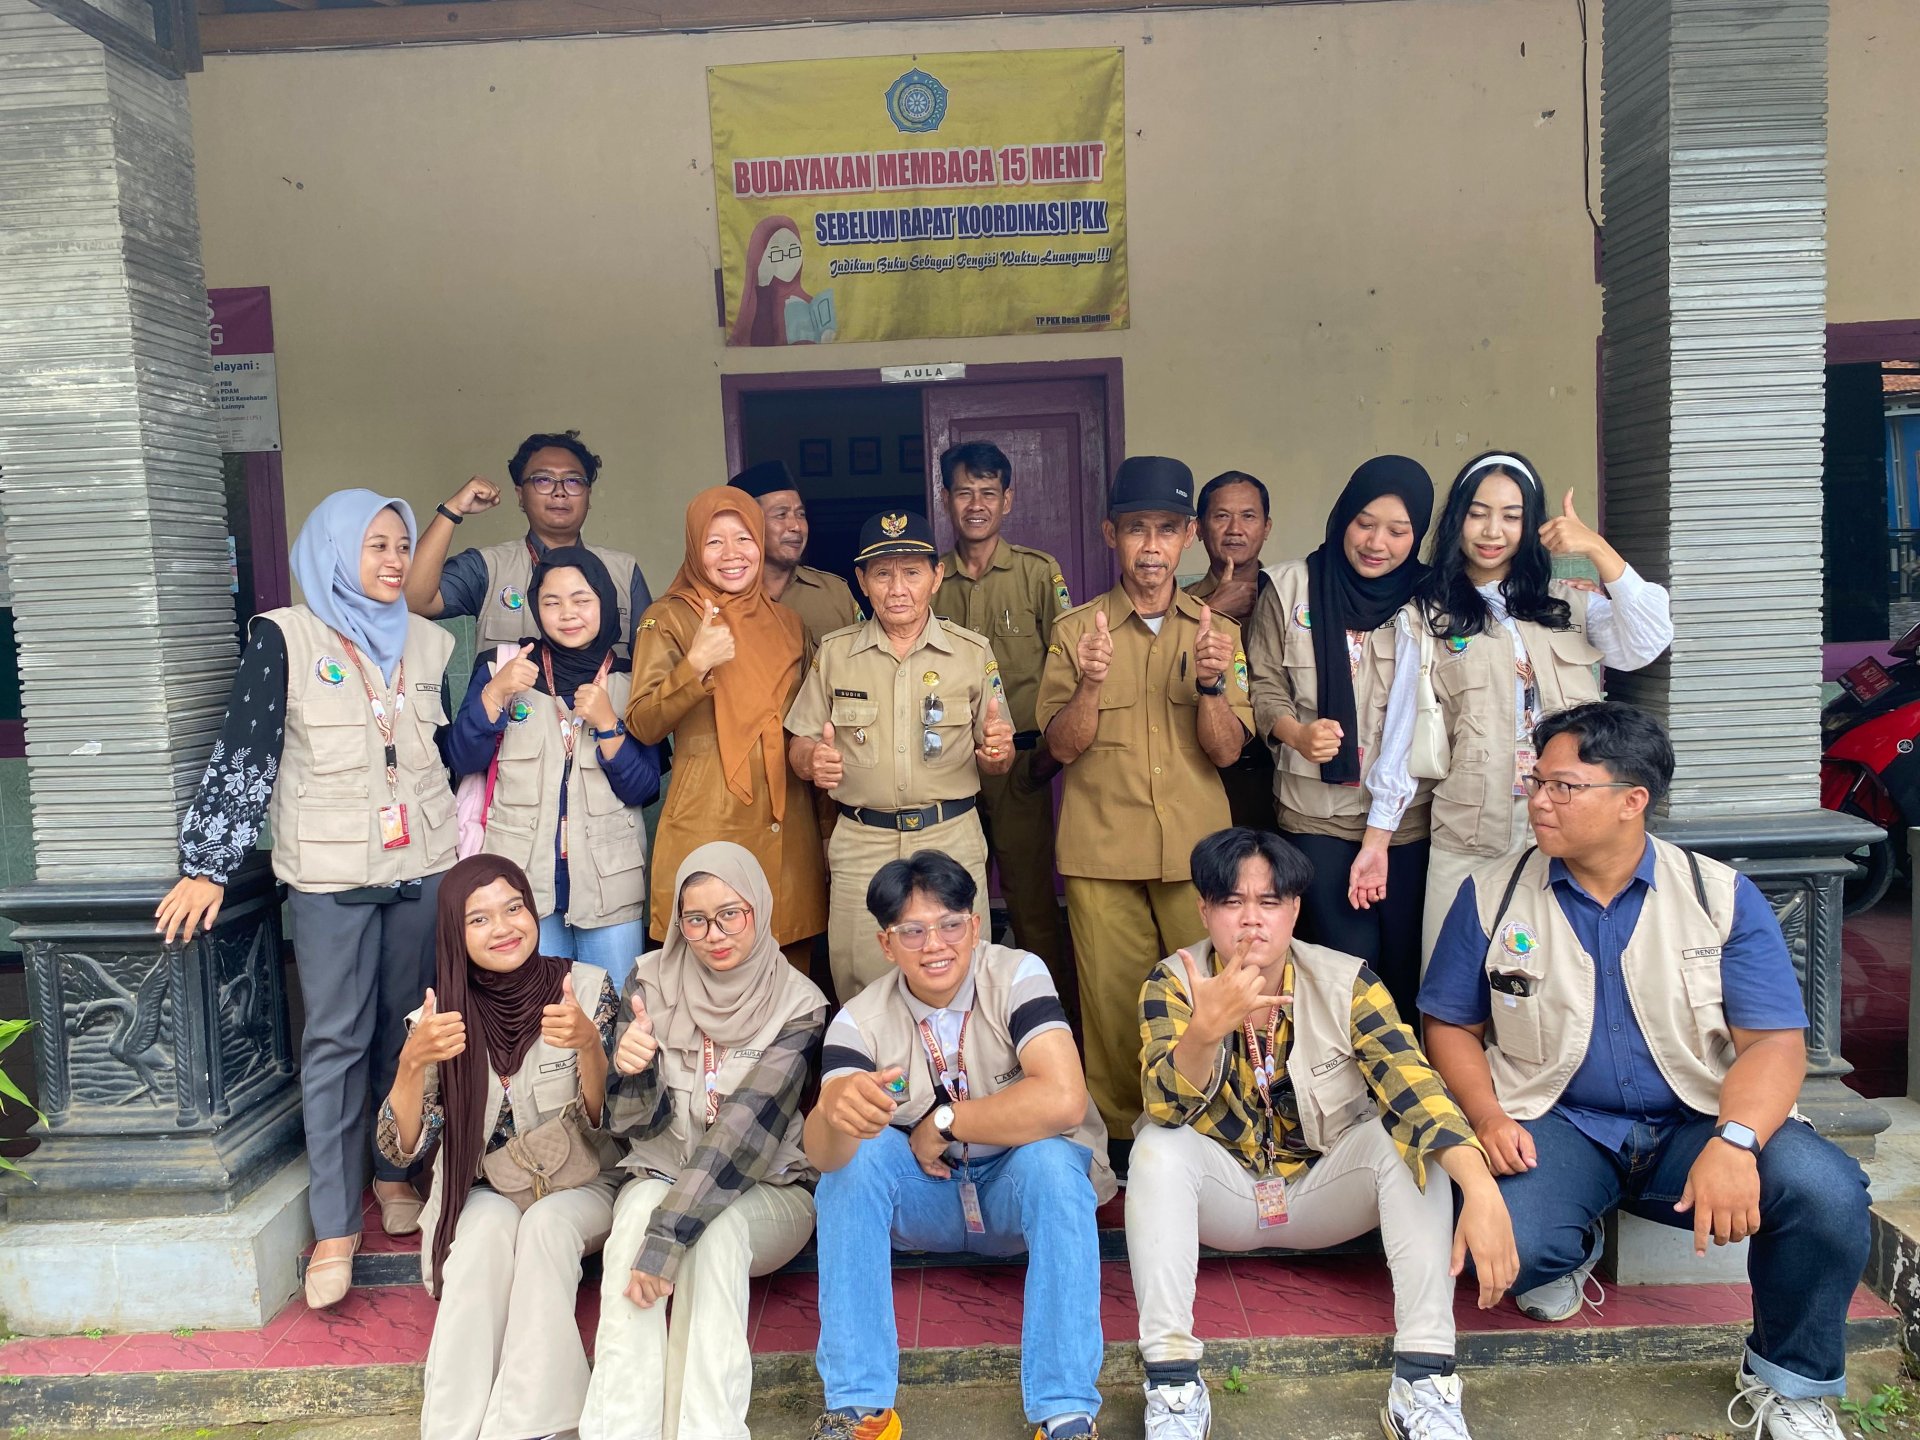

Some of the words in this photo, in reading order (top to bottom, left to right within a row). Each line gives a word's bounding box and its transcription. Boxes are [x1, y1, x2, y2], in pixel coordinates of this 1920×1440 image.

[734, 154, 873, 194] BUDAYAKAN
[877, 149, 996, 188] MEMBACA
[998, 147, 1027, 182] 15
[1031, 143, 1105, 180] MENIT
[815, 209, 897, 242] SEBELUM
[900, 206, 955, 239] RAPAT
[957, 202, 1067, 236] KOORDINASI
[1071, 200, 1108, 230] PKK
[829, 258, 873, 276] Jadikan
[876, 256, 906, 271] Buku
[909, 254, 954, 271] Sebagai
[956, 251, 997, 268] Pengisi
[999, 250, 1038, 264] Waktu
[1039, 249, 1094, 265] Luangmu
[1096, 247, 1111, 260] !!!
[1035, 316, 1045, 325] TP
[1046, 316, 1061, 325] PKK
[1061, 315, 1080, 324] Desa
[903, 367, 944, 379] AULA
[1325, 1059, 1339, 1070] RIO
